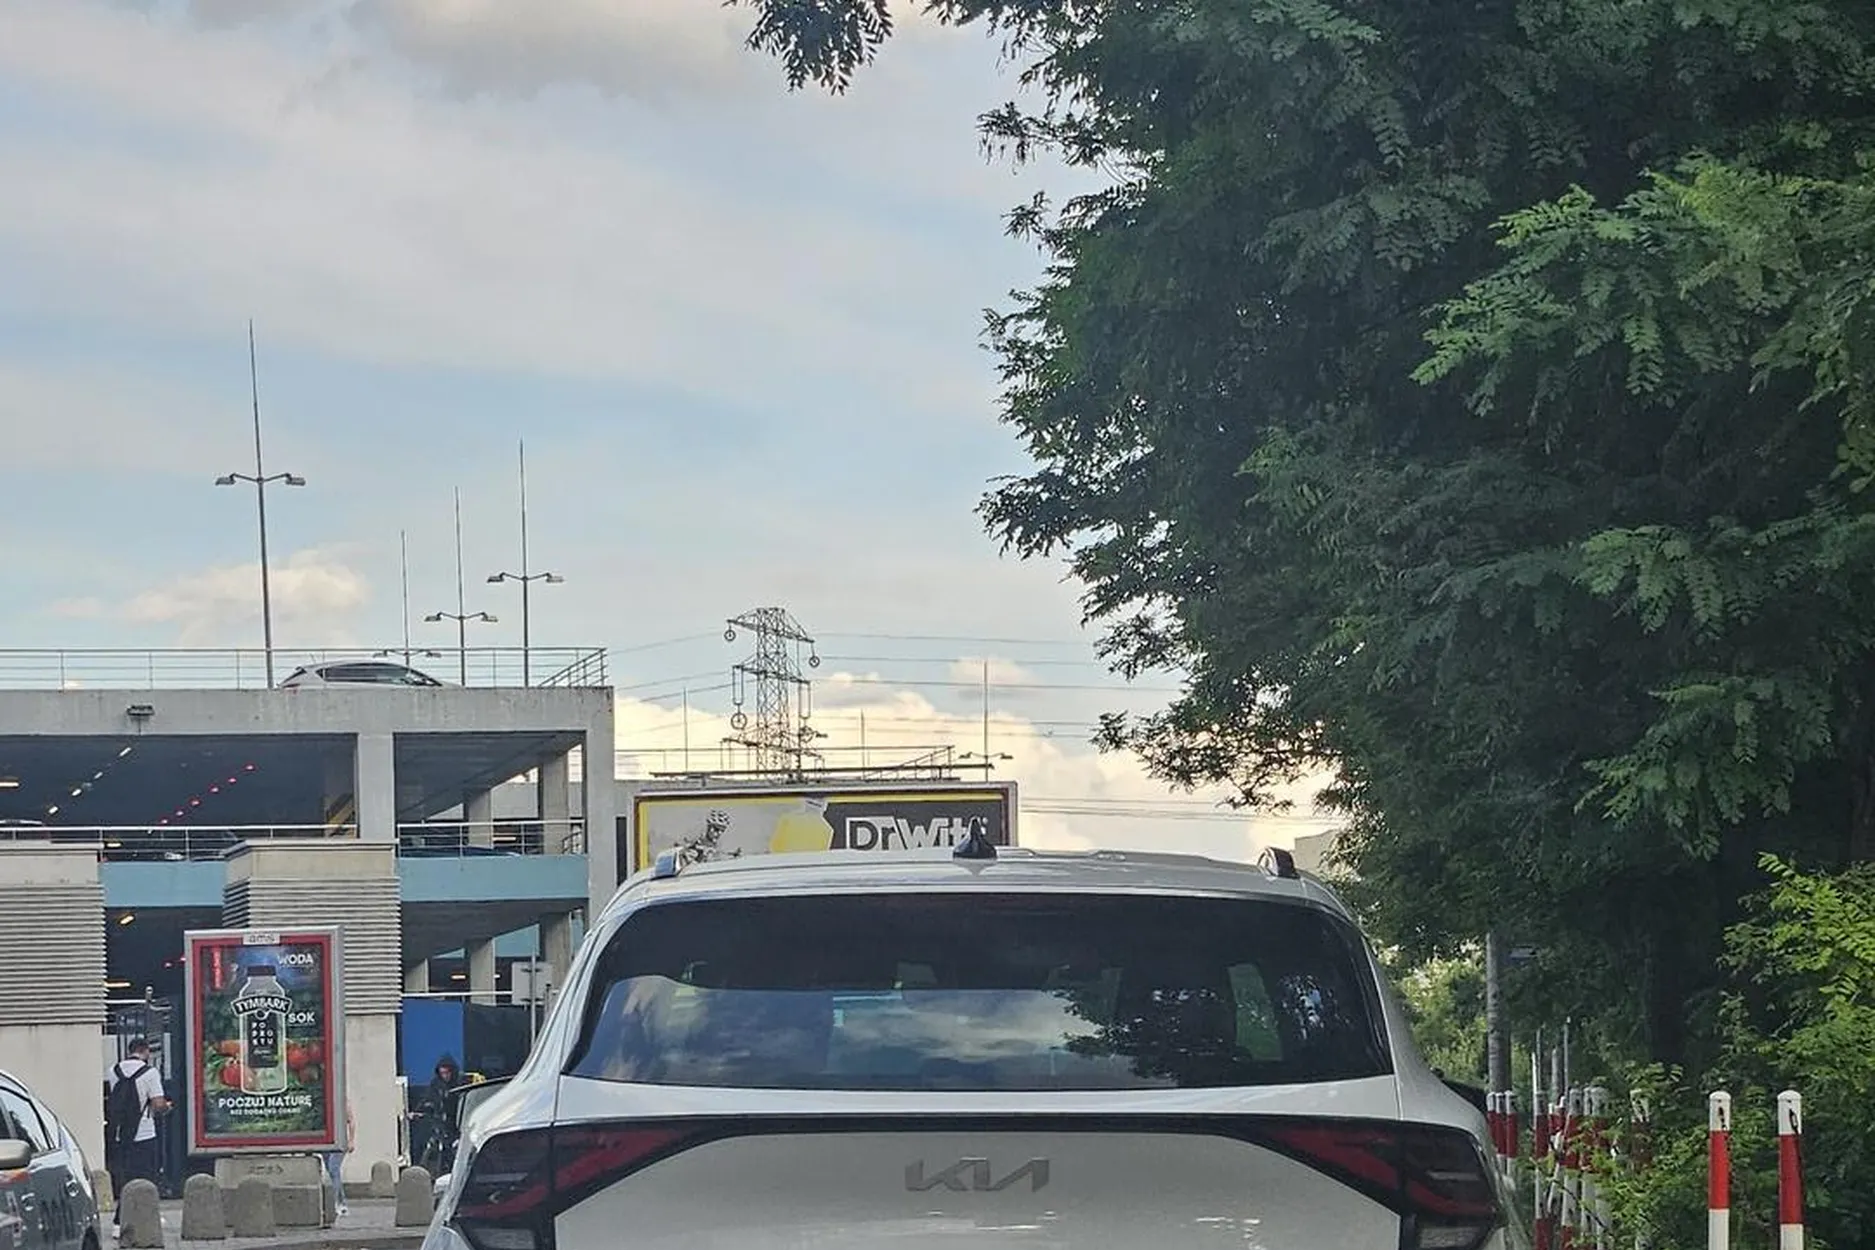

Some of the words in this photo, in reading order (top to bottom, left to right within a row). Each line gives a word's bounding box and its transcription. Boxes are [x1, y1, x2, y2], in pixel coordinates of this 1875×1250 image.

[288, 1011, 315, 1024] SOK
[218, 1097, 265, 1108] POCZUJ
[905, 1157, 1050, 1192] KIA
